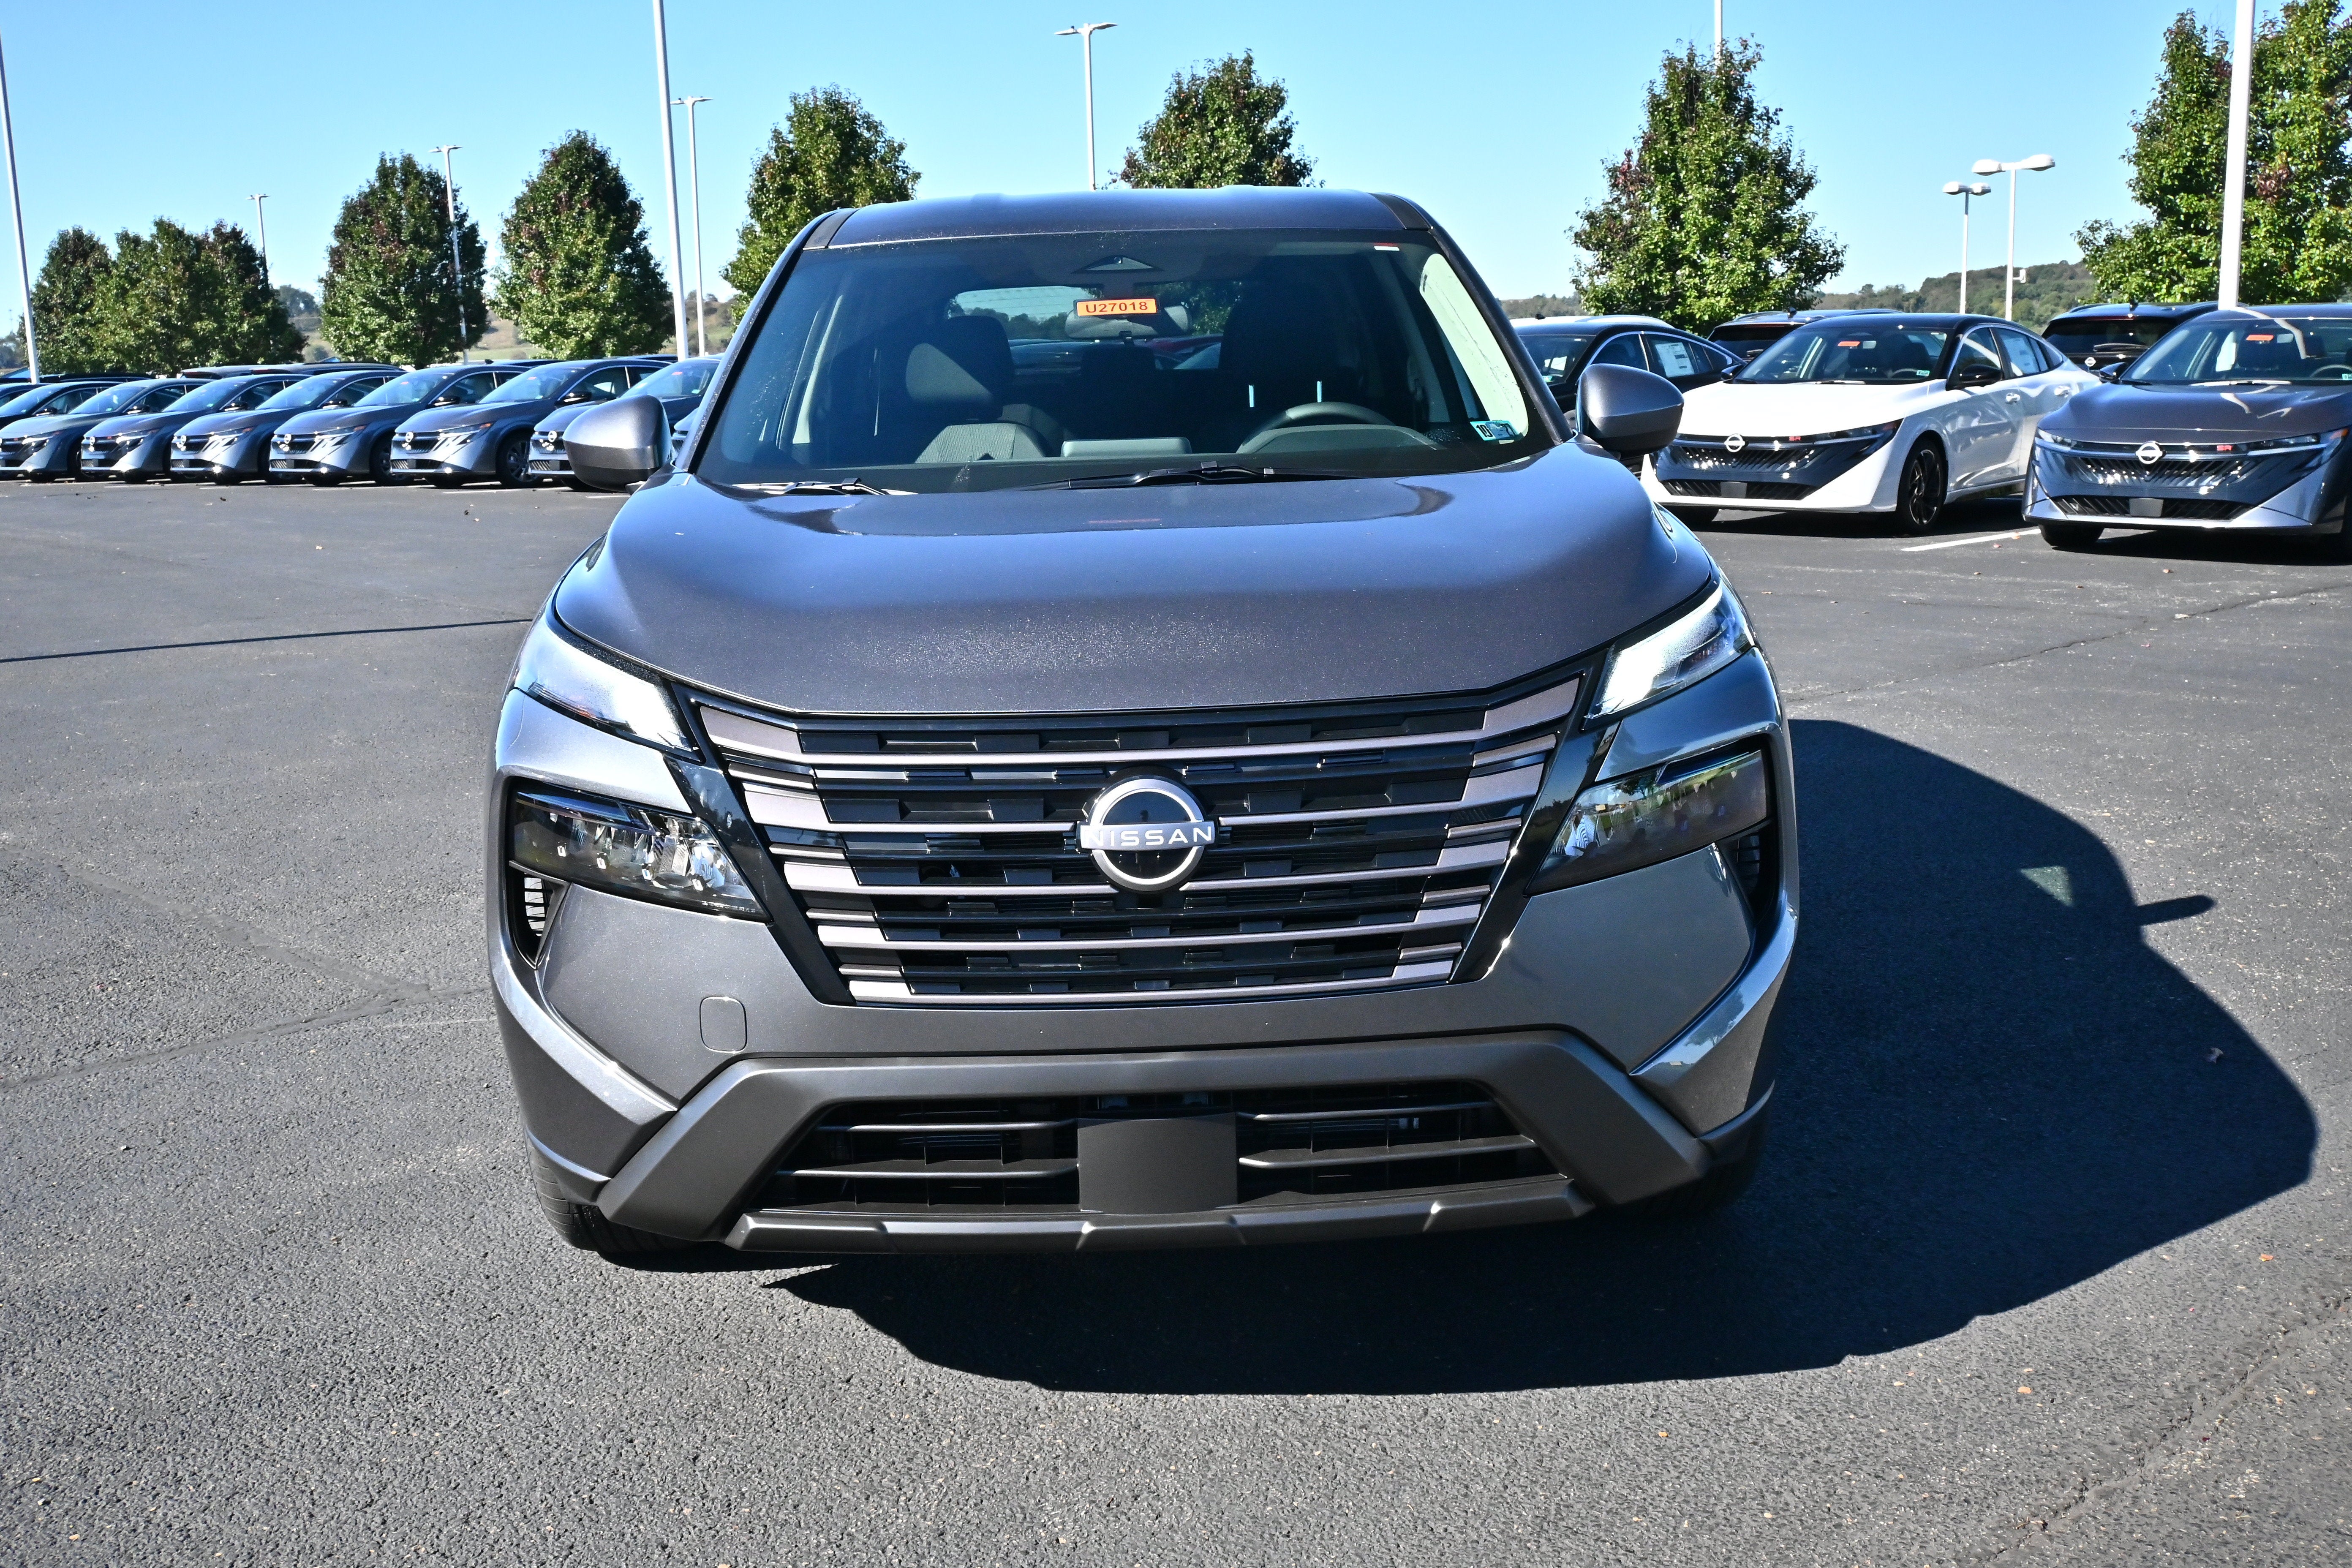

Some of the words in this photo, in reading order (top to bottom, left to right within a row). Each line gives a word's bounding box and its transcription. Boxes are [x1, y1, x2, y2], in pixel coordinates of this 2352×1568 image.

[1086, 301, 1148, 313] U27018
[1476, 425, 1493, 438] 10
[1084, 826, 1212, 847] NISSAN
